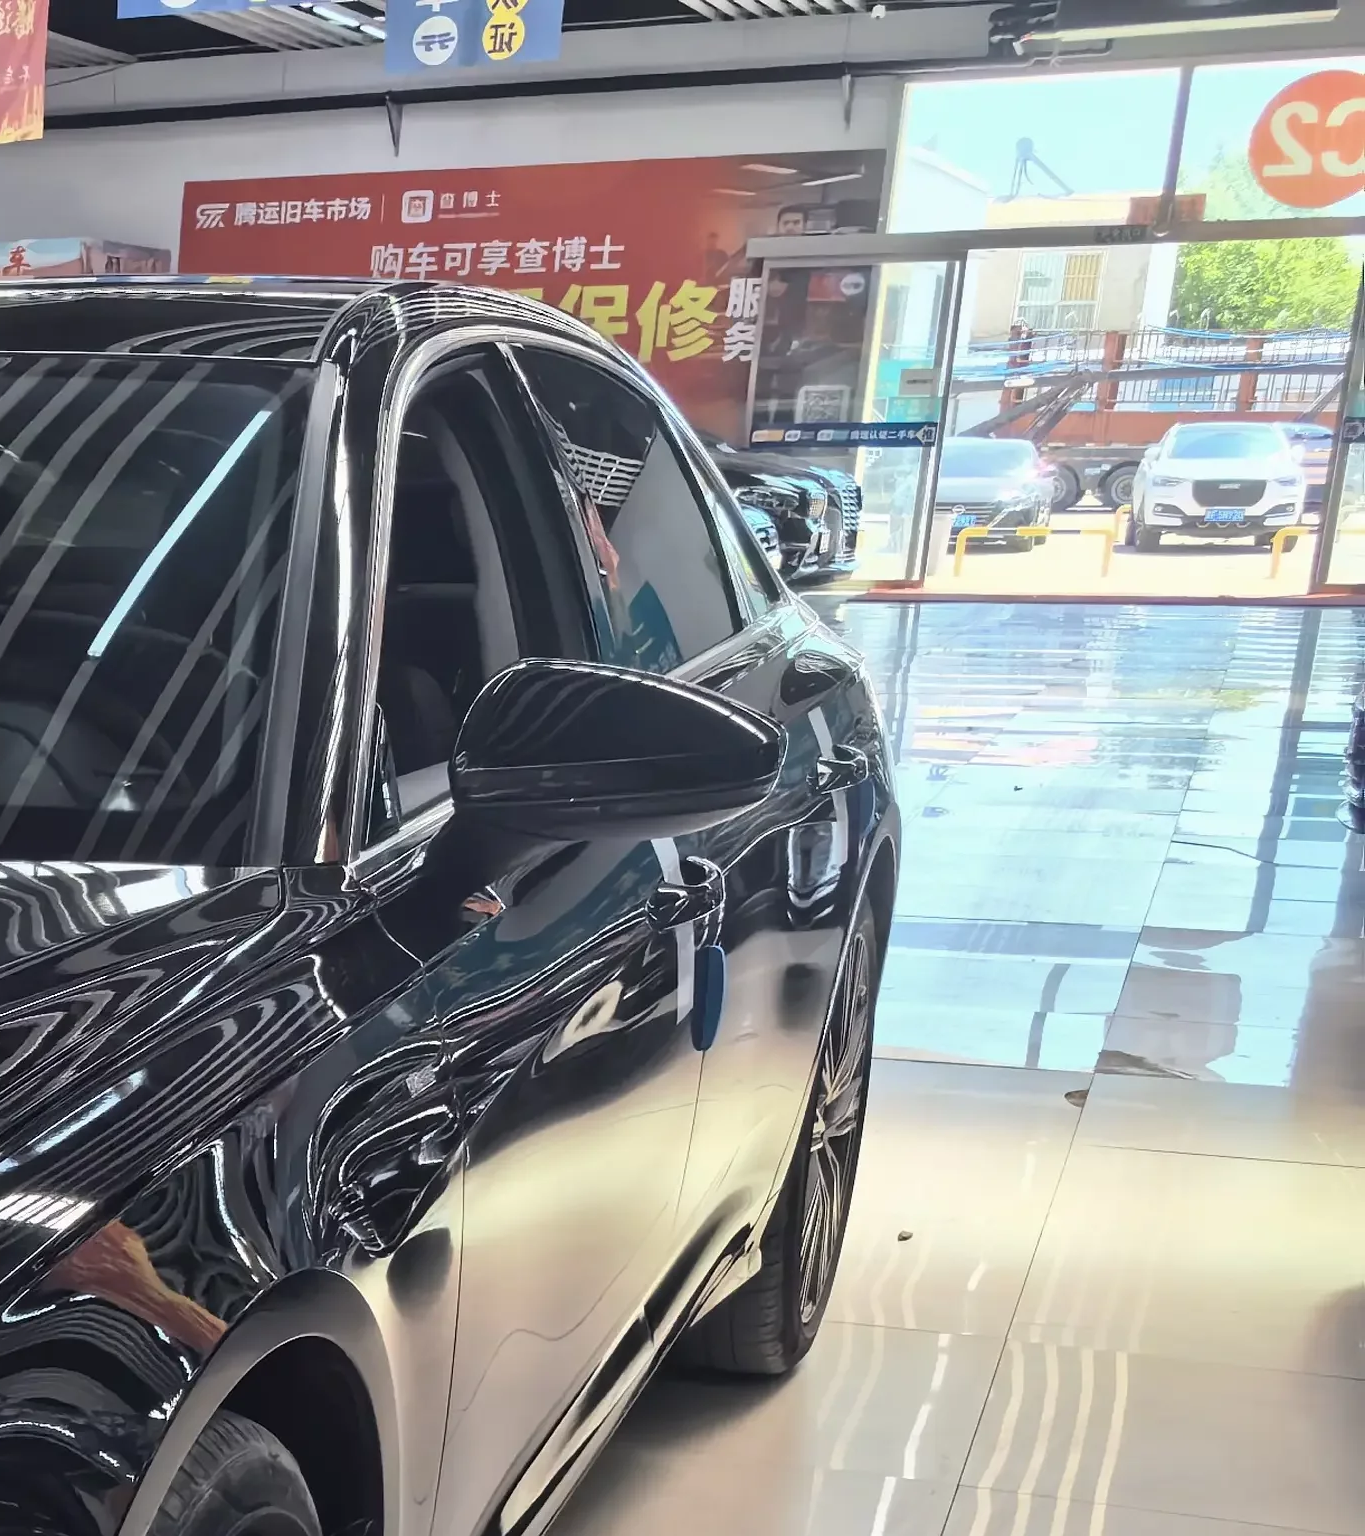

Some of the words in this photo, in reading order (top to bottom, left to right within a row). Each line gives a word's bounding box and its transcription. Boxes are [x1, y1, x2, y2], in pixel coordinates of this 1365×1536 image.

[233, 196, 372, 226] 腾运旧车市场
[369, 235, 626, 281] 购车可享查博士
